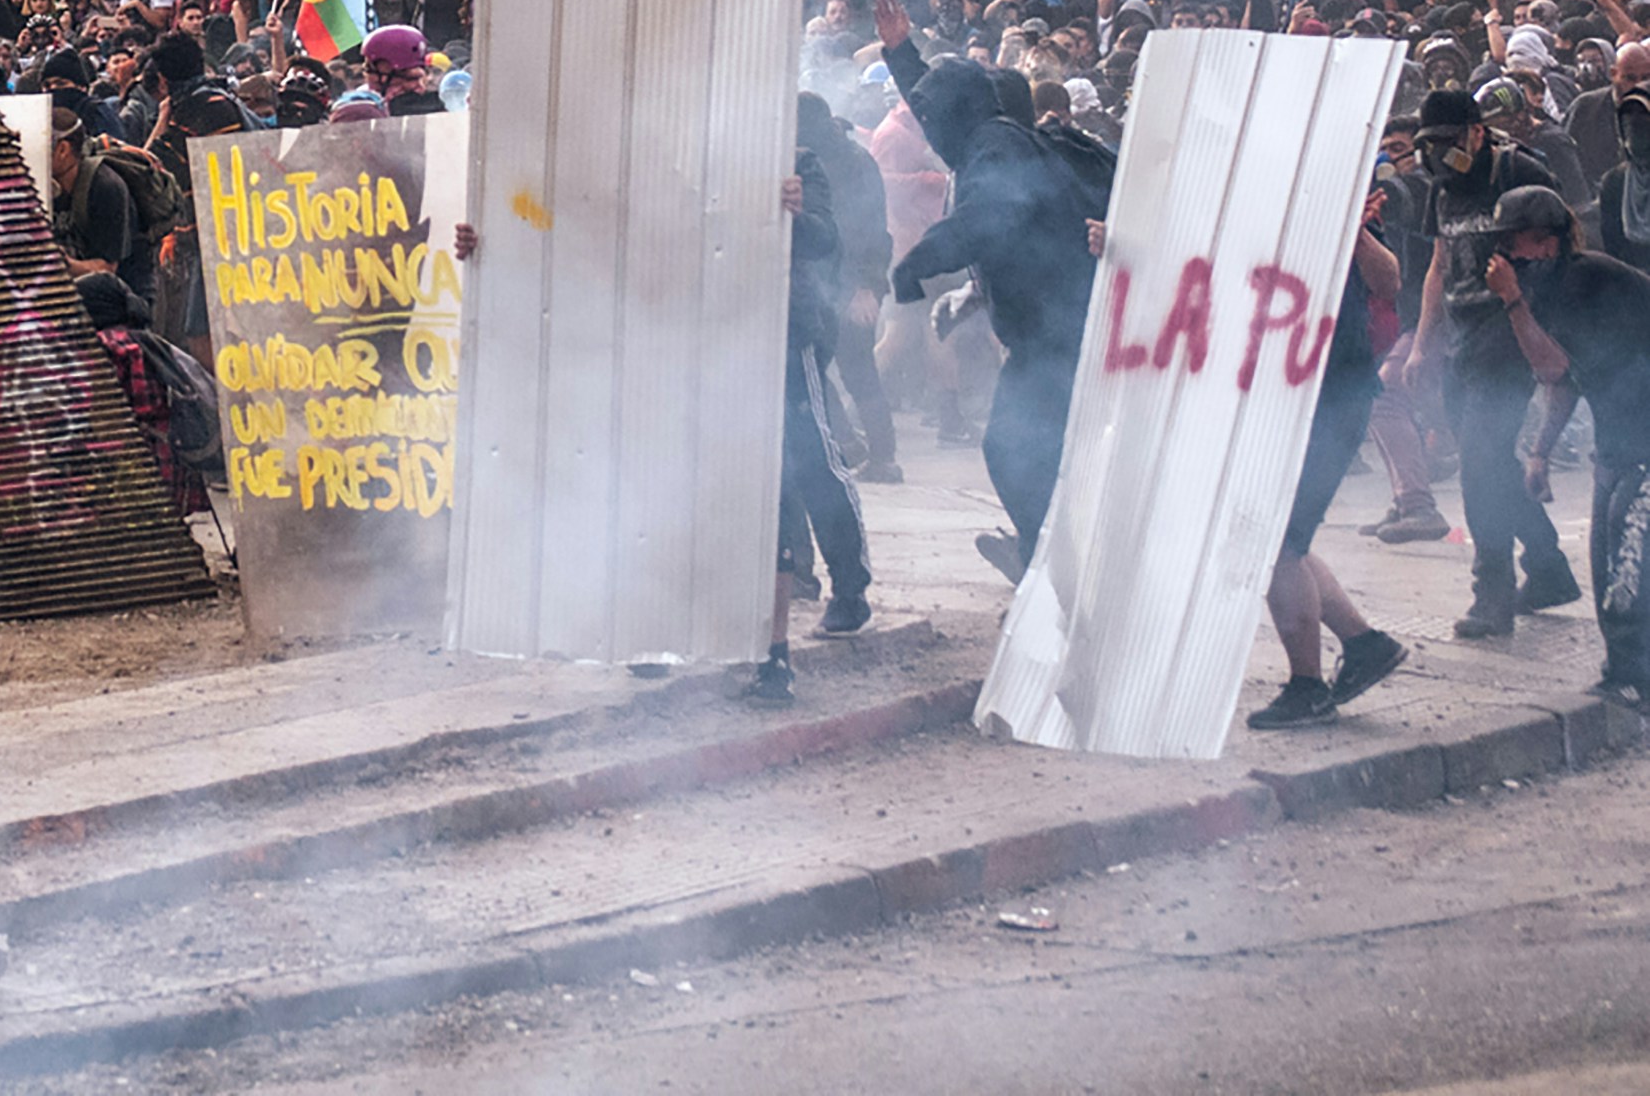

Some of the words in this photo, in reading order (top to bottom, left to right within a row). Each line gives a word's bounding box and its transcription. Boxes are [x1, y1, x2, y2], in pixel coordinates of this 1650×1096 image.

[216, 254, 303, 306] PARA
[300, 243, 462, 314] NUNCA
[1105, 257, 1213, 375] LA
[230, 398, 287, 446] UN
[229, 446, 293, 516] FUE
